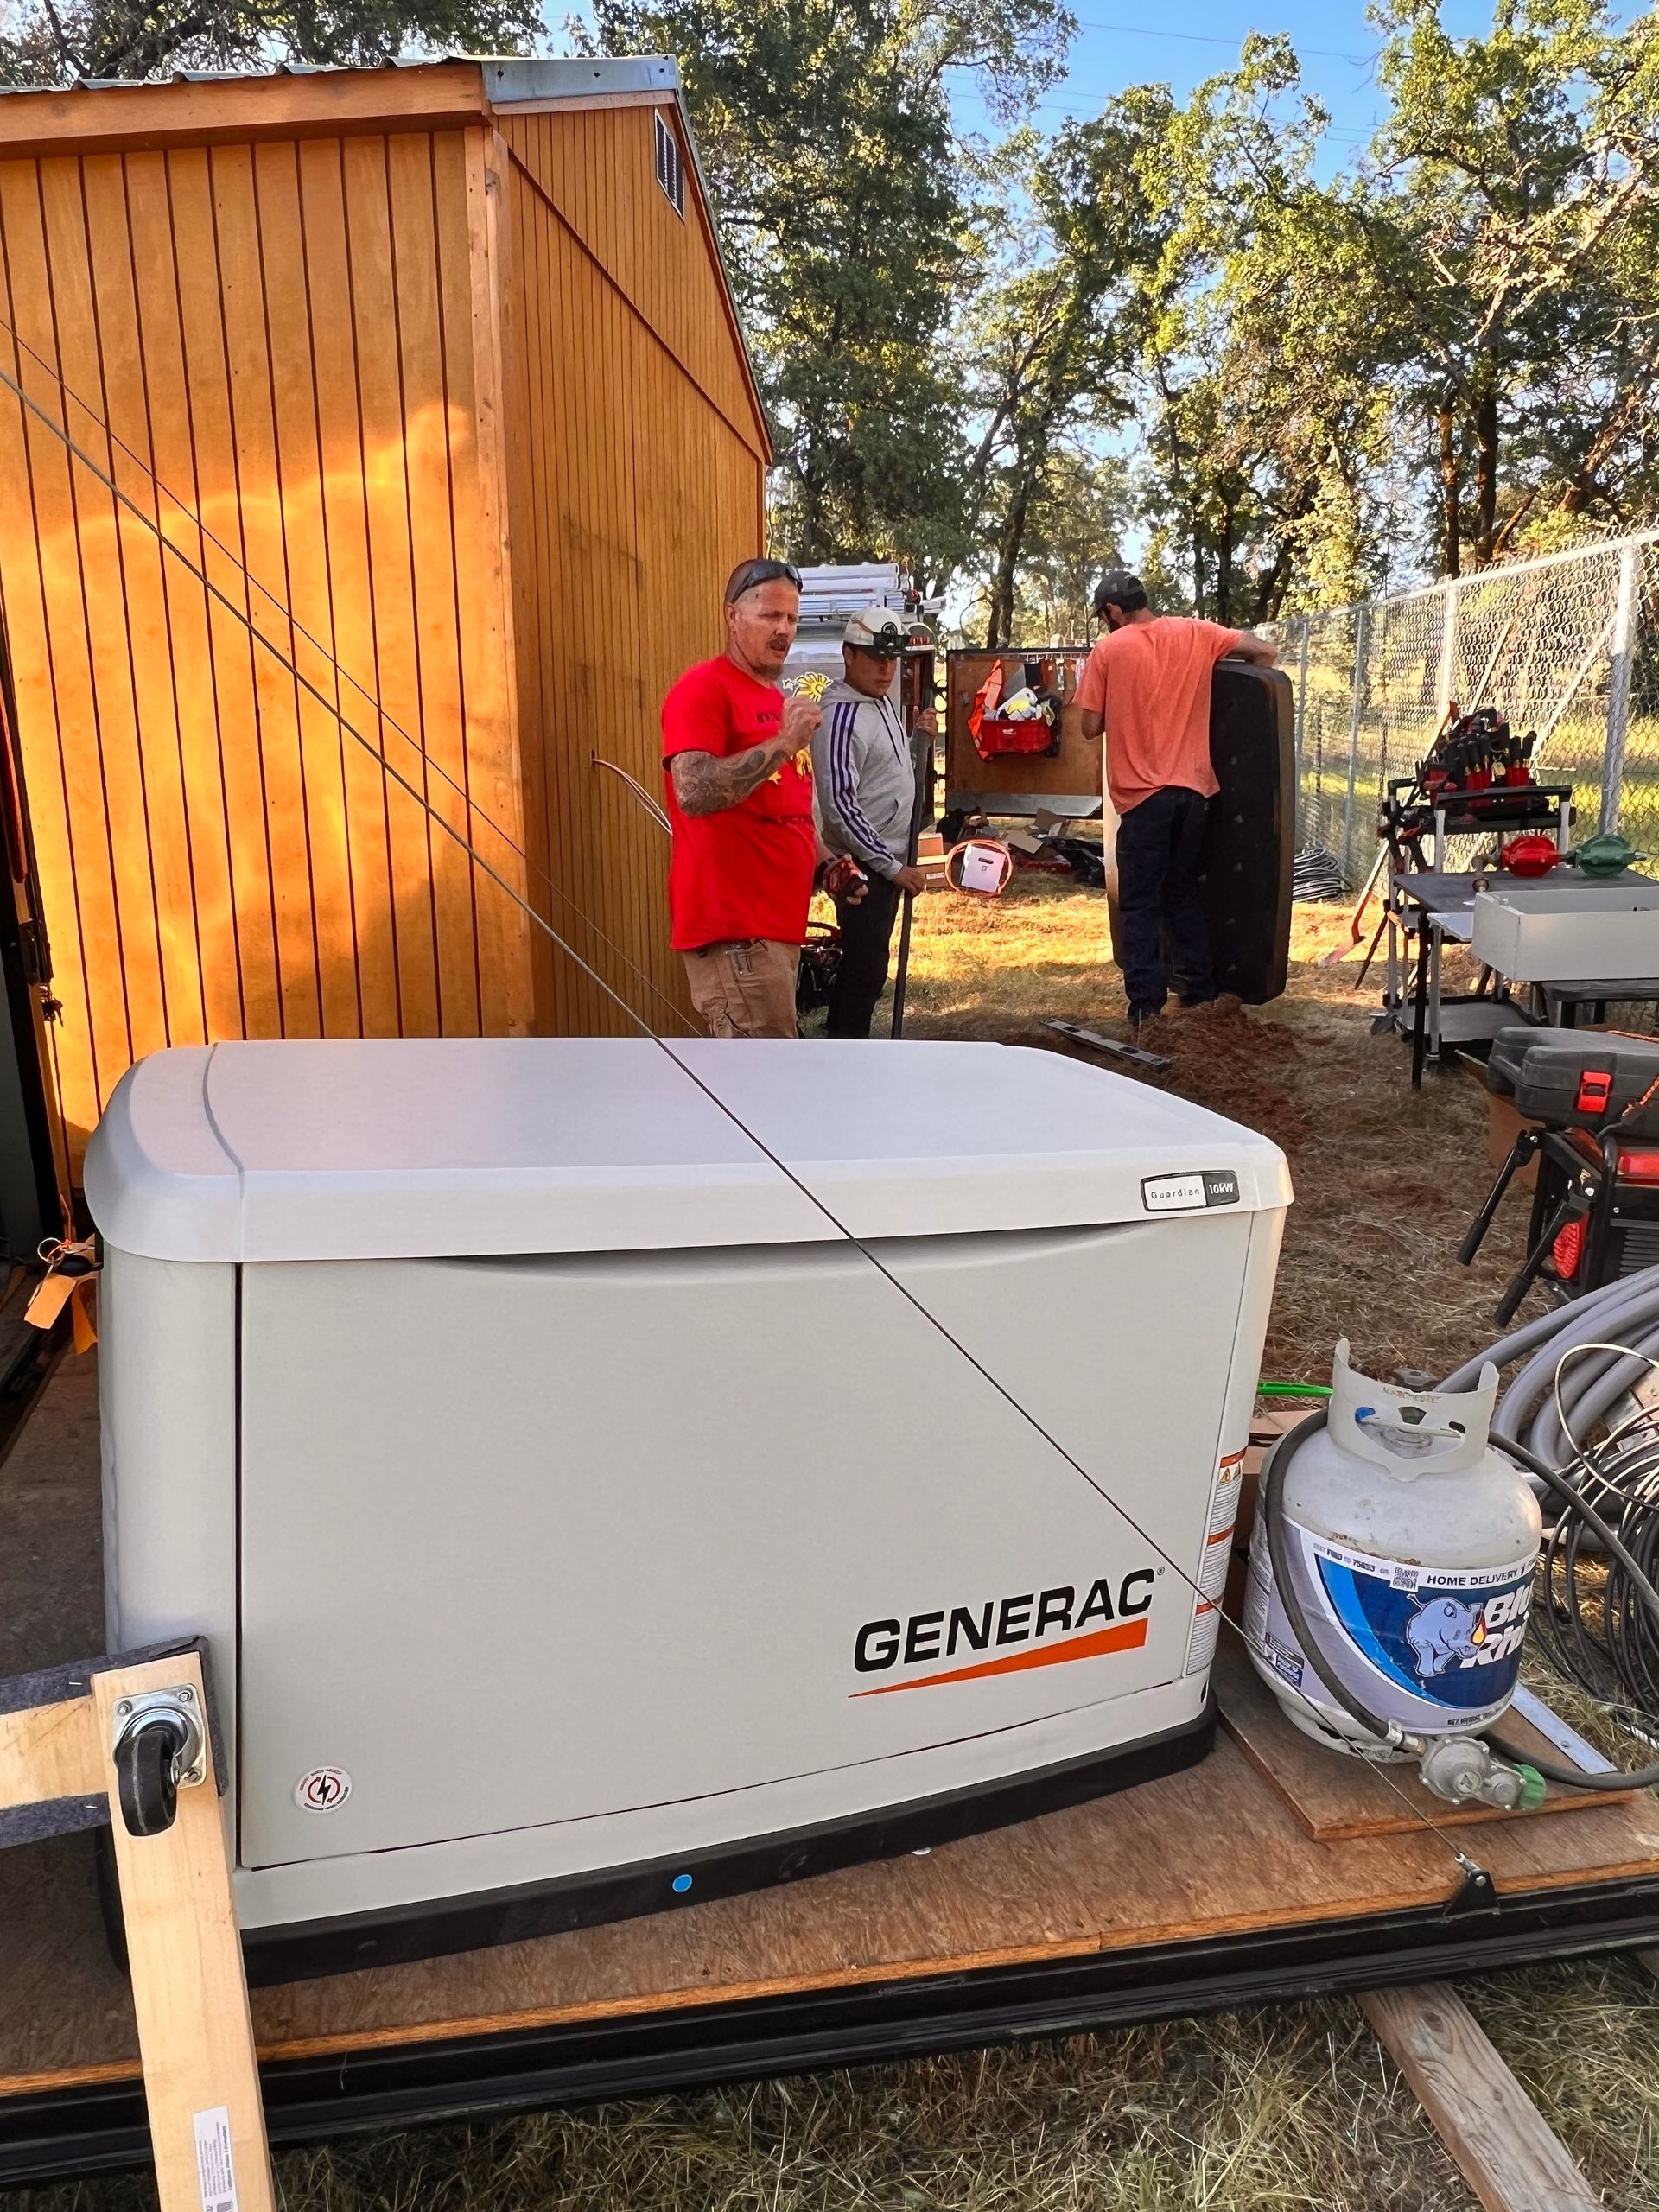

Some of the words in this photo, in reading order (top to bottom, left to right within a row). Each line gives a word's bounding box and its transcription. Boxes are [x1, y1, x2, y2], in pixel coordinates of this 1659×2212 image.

[1151, 1188, 1200, 1199] Guardian
[1208, 1182, 1234, 1195] 10kW
[1427, 1574, 1467, 1586] HOME
[1470, 1568, 1519, 1586] DELIVERY
[854, 1568, 1155, 1673] GENERAC
[1484, 1582, 1534, 1629] Blu
